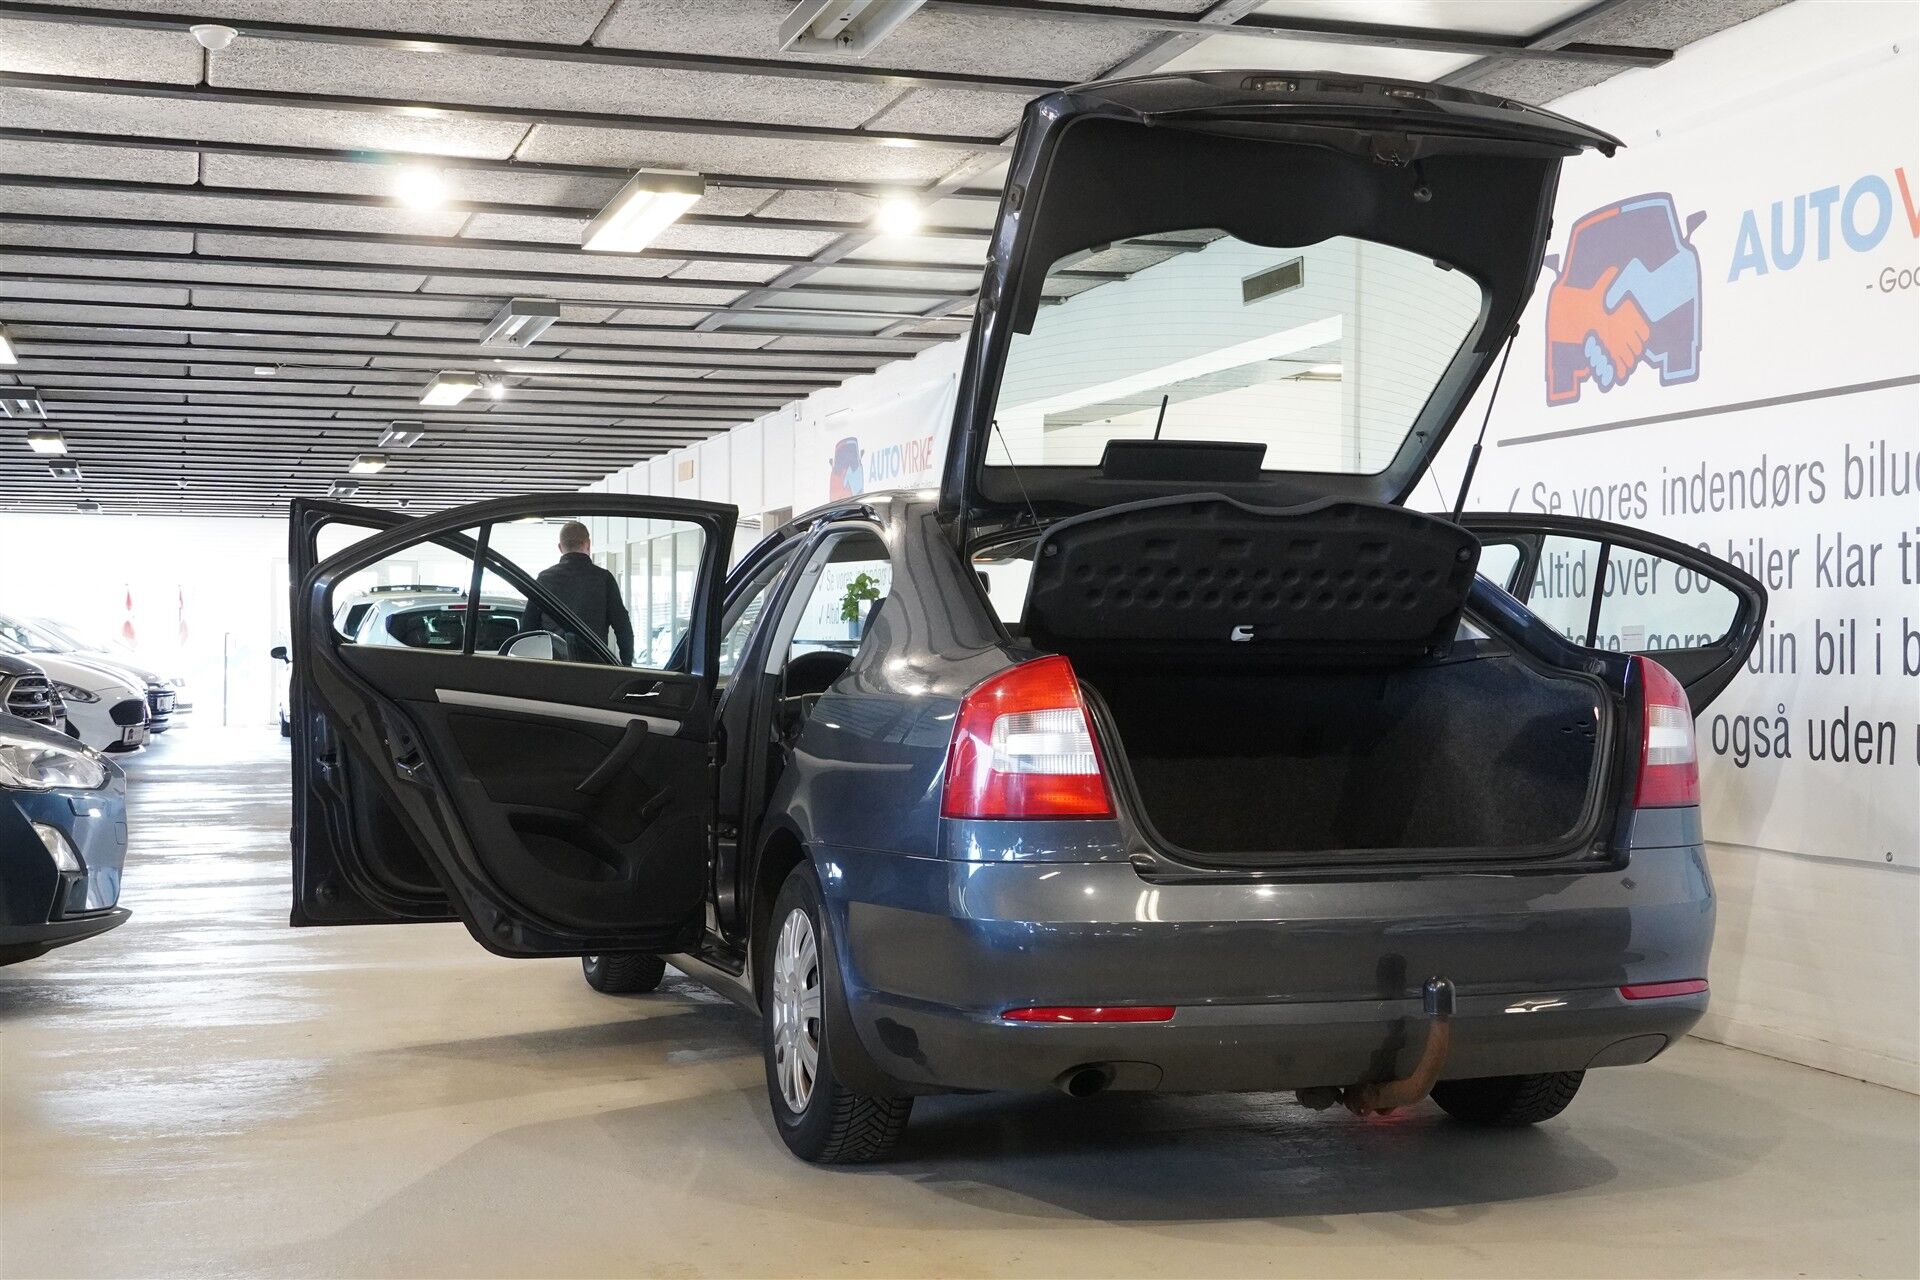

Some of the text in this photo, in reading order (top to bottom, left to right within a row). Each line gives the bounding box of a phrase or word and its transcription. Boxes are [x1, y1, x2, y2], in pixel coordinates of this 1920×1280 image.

[1727, 167, 1919, 283] AUTOV
[869, 436, 933, 483] AUTOVIRKE
[1532, 482, 1561, 514] Se
[1573, 481, 1648, 521] vores
[1662, 454, 1826, 516] indendørs
[1531, 550, 1586, 599] Altid
[1603, 556, 1662, 598] over
[1816, 532, 1882, 588] klar
[1816, 618, 1855, 675] bil
[1876, 618, 1881, 675] i
[1712, 703, 1791, 768] også
[1808, 706, 1896, 765] uden
